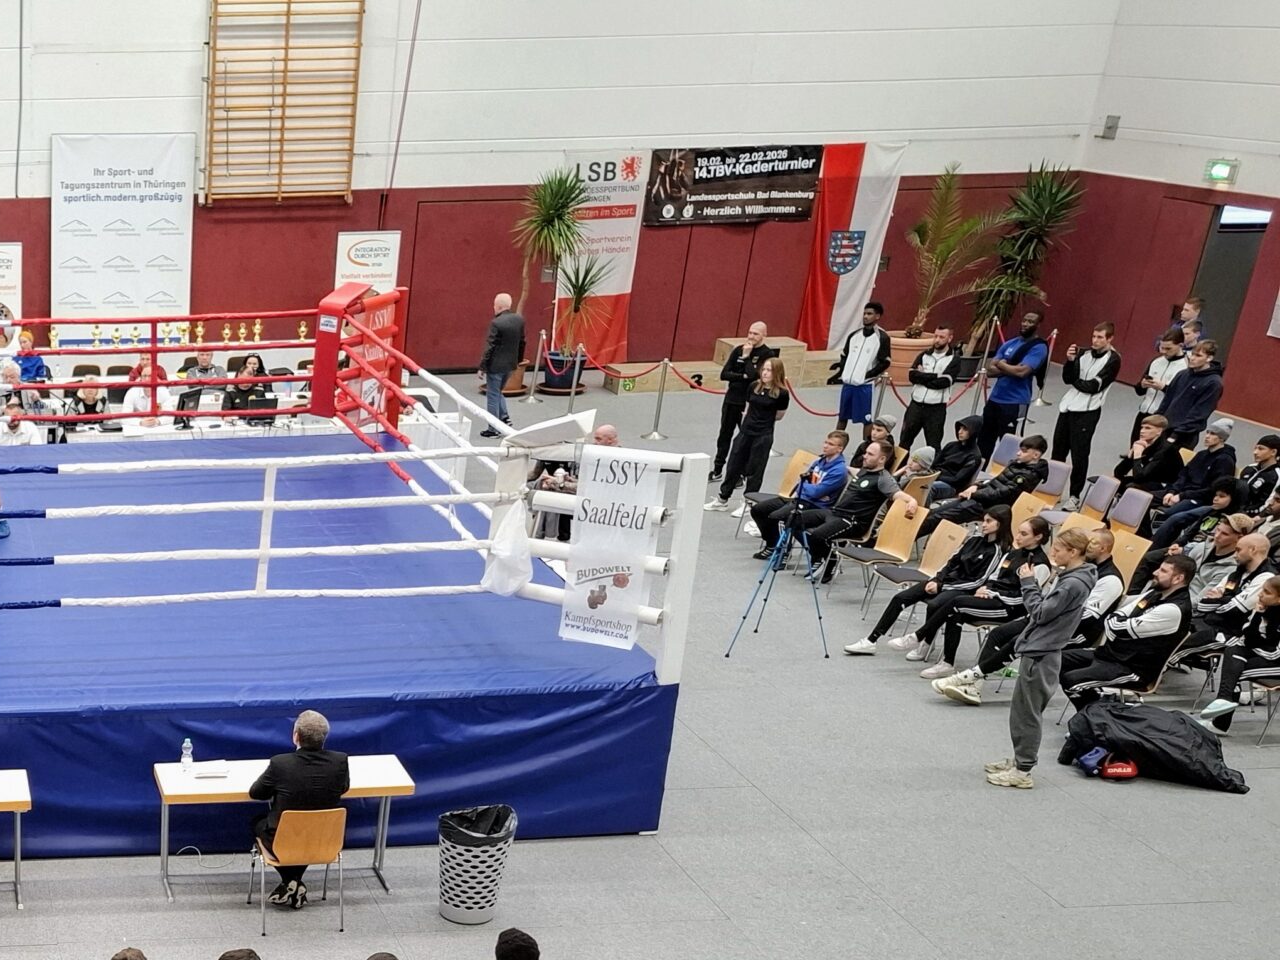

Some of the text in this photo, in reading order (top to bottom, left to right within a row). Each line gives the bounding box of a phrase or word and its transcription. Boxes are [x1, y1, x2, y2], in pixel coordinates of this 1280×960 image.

[697, 157, 723, 167] 19.02.
[739, 150, 788, 162] 22.02.2026
[93, 168, 154, 178] Ihr Sport- und
[577, 162, 617, 182] LSB
[693, 157, 816, 180] 14.TBV-Kaderturnier
[60, 180, 186, 191] Tagungszentrum in Thüringen
[686, 190, 815, 202] Landessportschule Bad Blankenburg
[703, 205, 742, 216] Herzlich
[745, 204, 796, 215] Willkommen
[592, 458, 648, 488] 1.SSV
[578, 498, 648, 530] Saalfeld
[576, 566, 632, 581] BUDOWELT
[564, 610, 632, 633] Kampfsportshop
